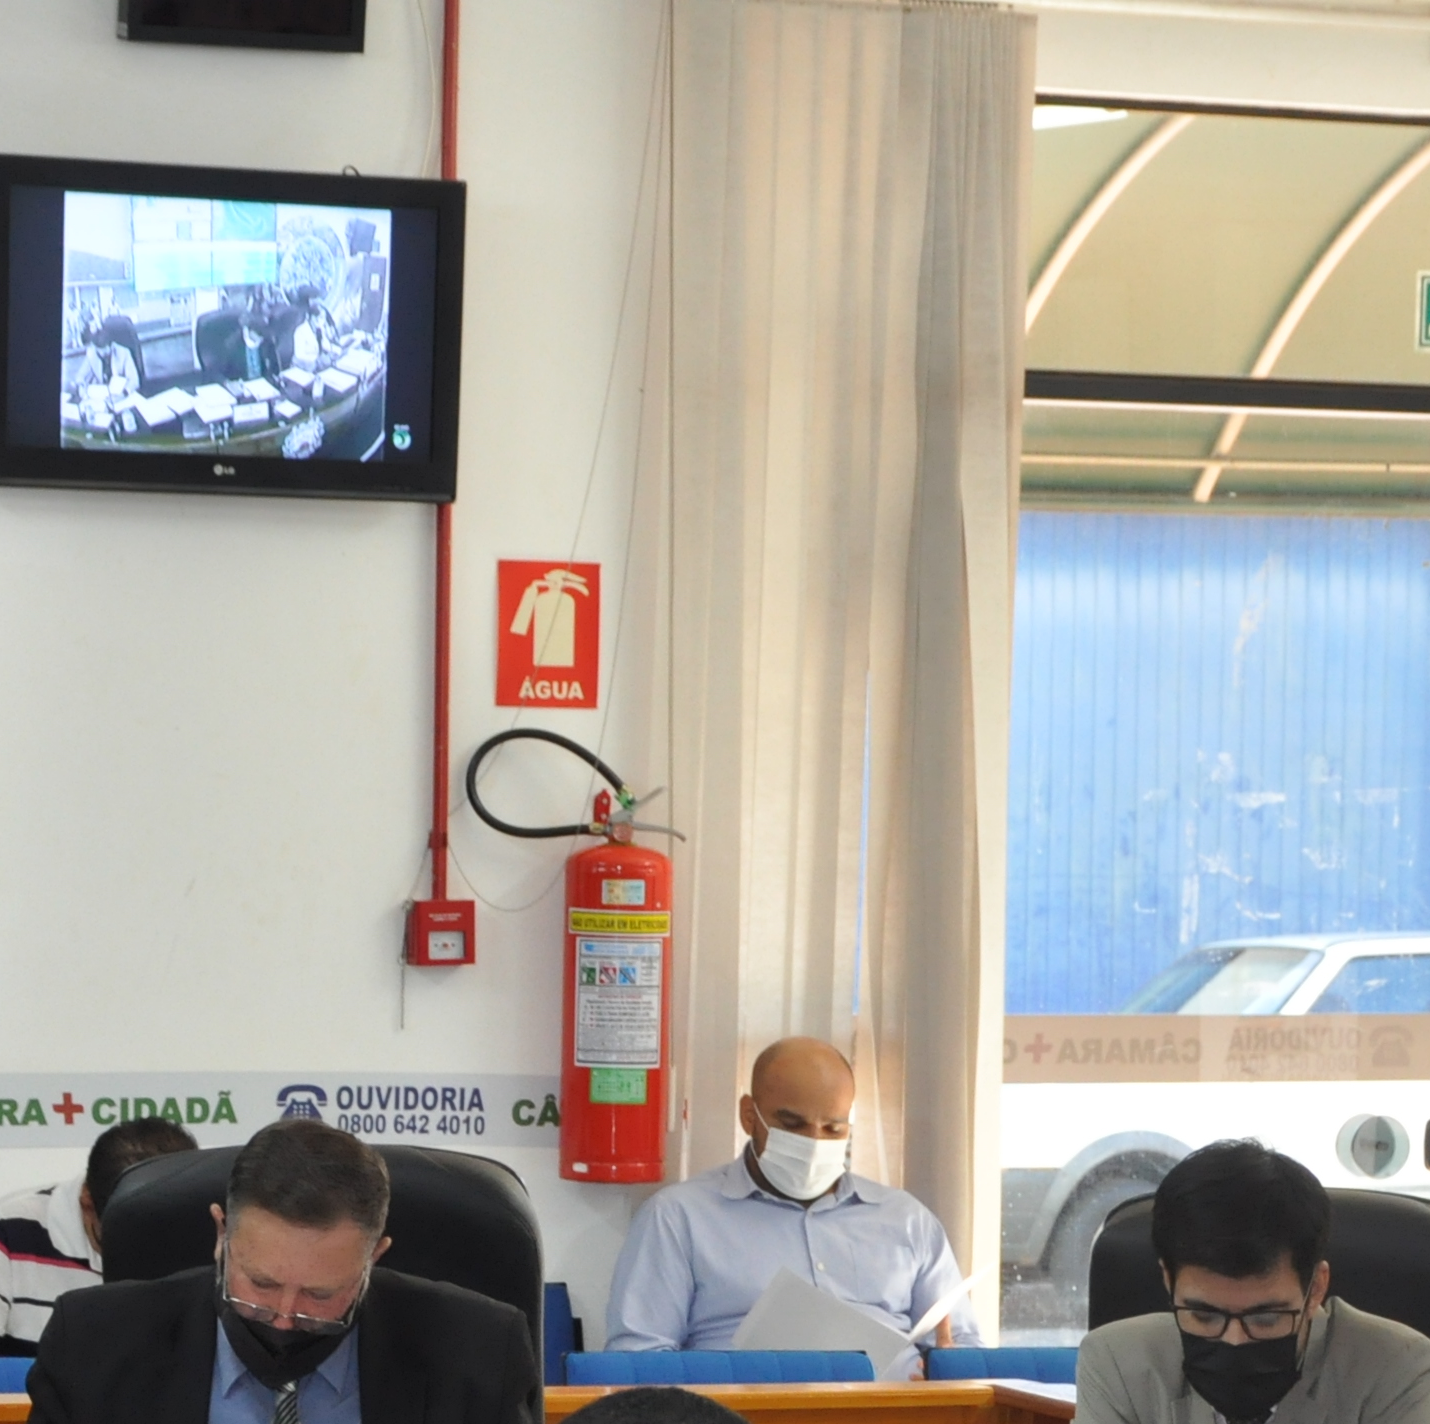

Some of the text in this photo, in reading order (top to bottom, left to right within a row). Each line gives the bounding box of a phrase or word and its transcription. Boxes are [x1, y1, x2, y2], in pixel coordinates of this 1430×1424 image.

[519, 676, 584, 700] ÁGUA
[336, 1086, 484, 1112] OUVIDORIA
[337, 1114, 485, 1135] 0800 642 4010
